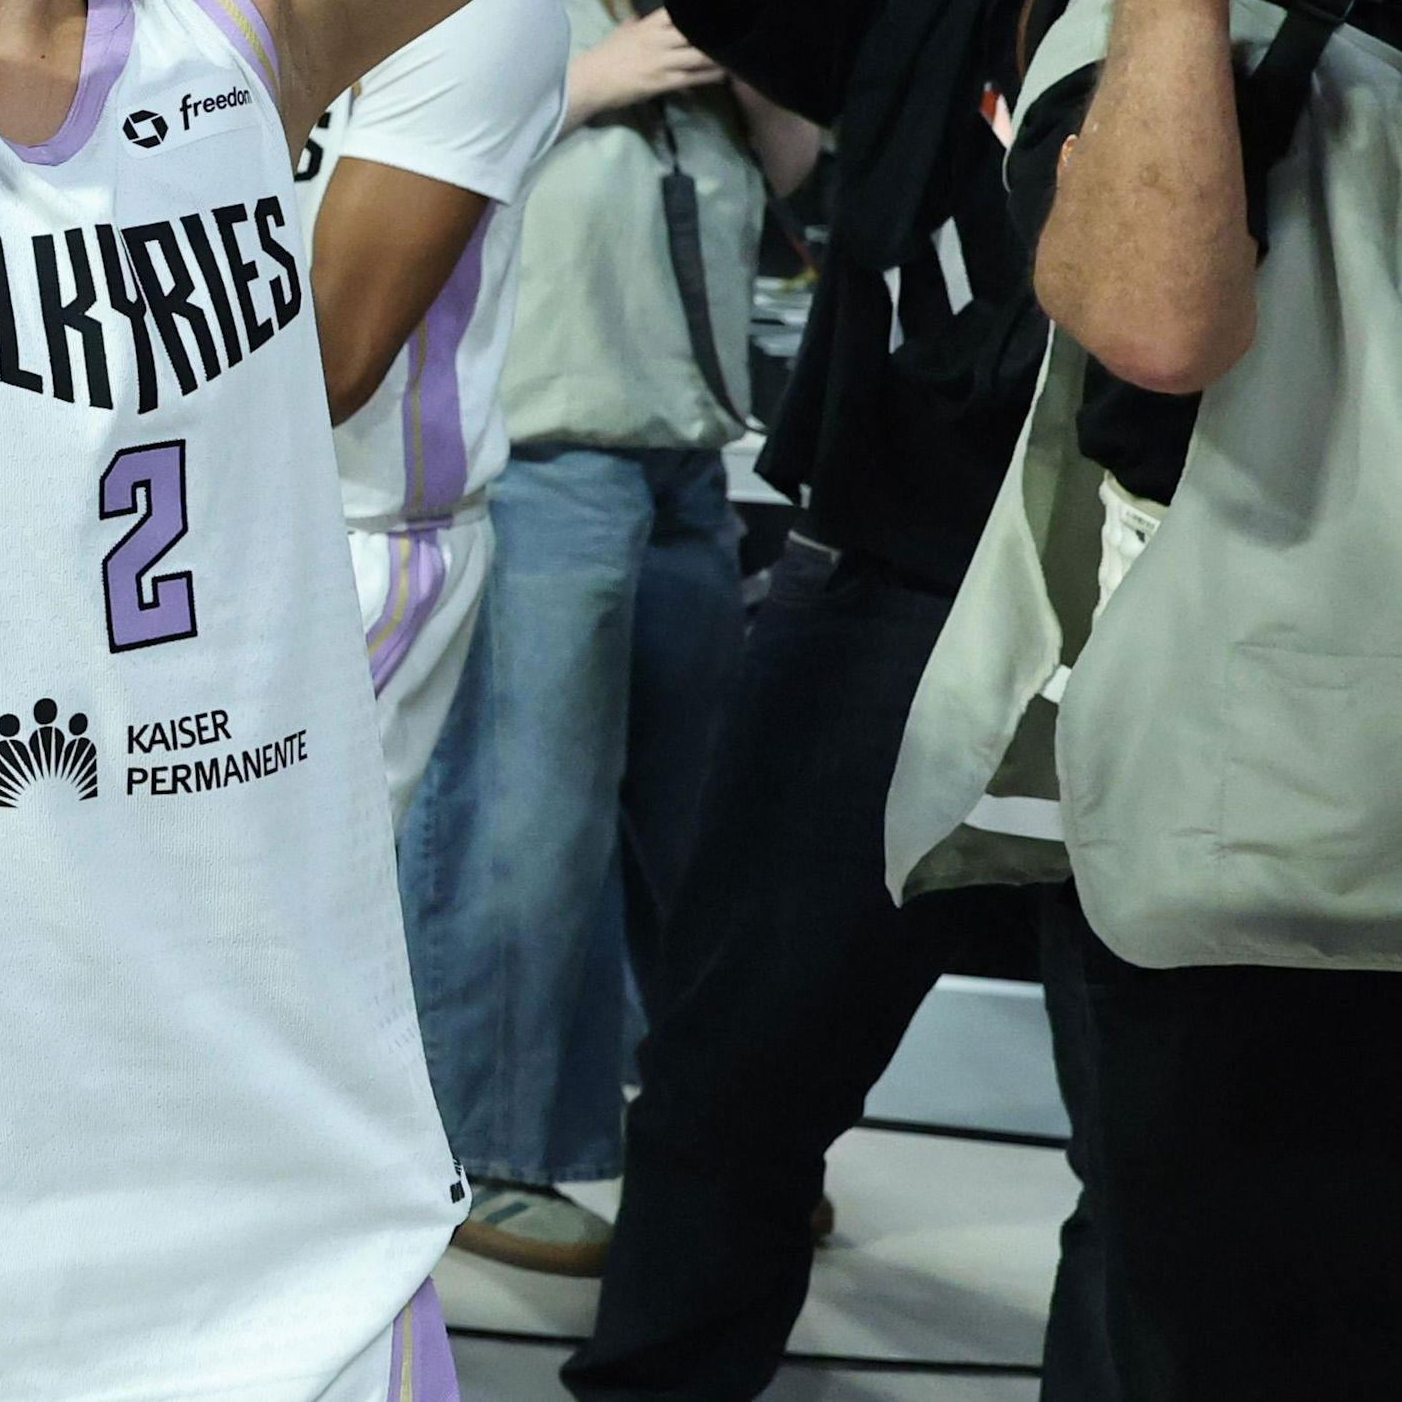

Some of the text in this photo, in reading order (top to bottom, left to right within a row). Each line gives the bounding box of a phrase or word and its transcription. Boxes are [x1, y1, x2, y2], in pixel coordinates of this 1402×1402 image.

[98, 438, 198, 655] 2
[126, 729, 308, 796] PERMANENTE
[127, 710, 232, 754] KAISER
